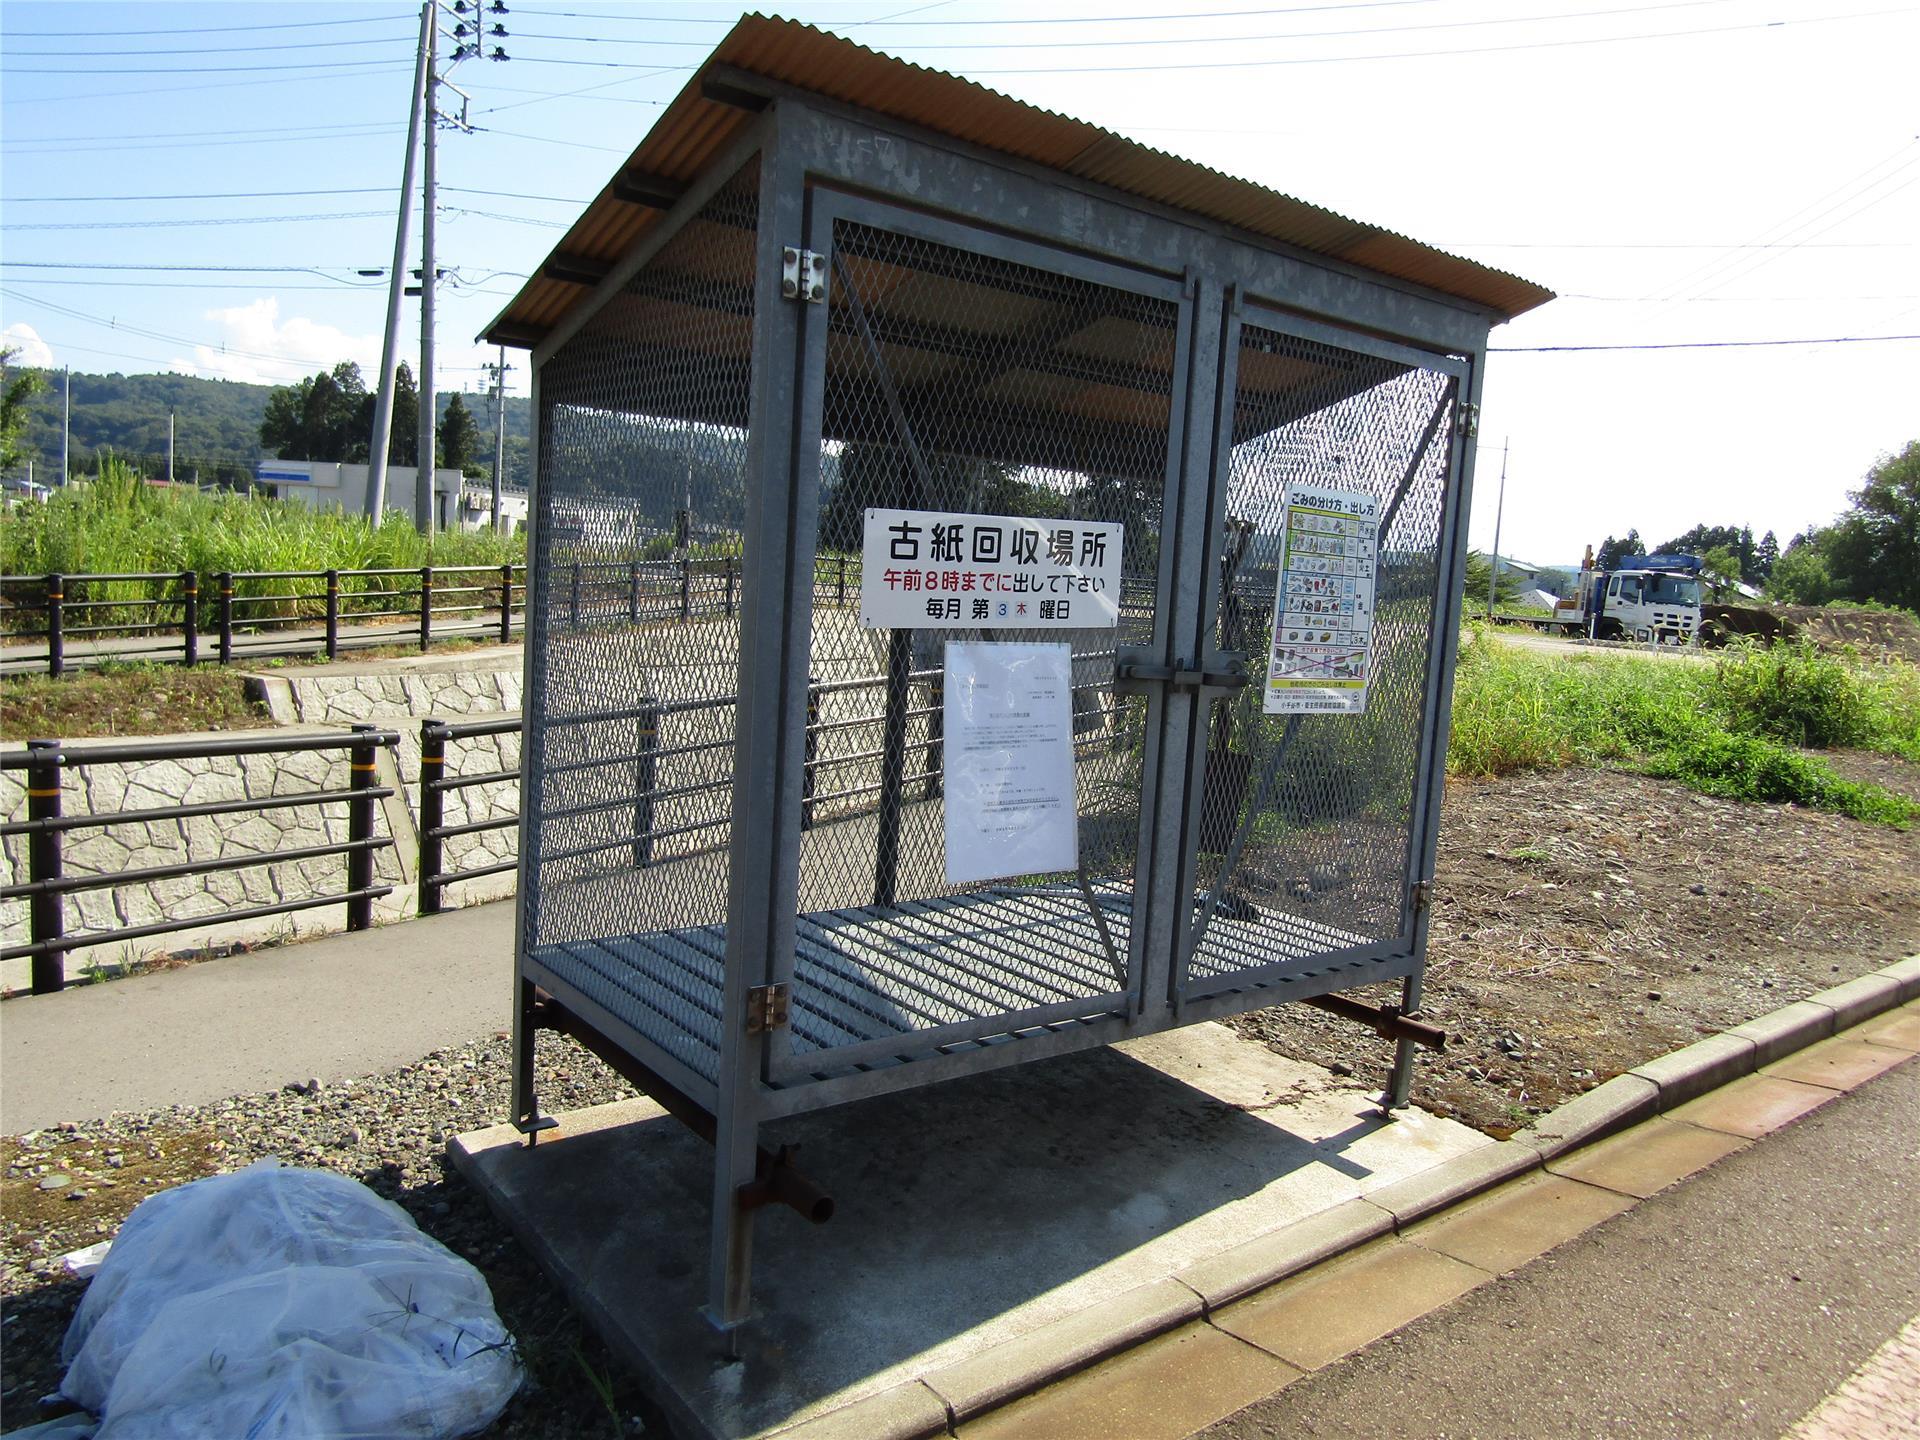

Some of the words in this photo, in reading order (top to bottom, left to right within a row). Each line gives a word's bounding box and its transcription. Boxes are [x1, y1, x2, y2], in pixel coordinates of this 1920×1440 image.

[1291, 492, 1375, 516] ごみの分け方・出し方
[888, 520, 1107, 567] 古紙回収場所
[883, 568, 1105, 593] 午前8時までに出して下さい
[925, 598, 960, 620] 毎月
